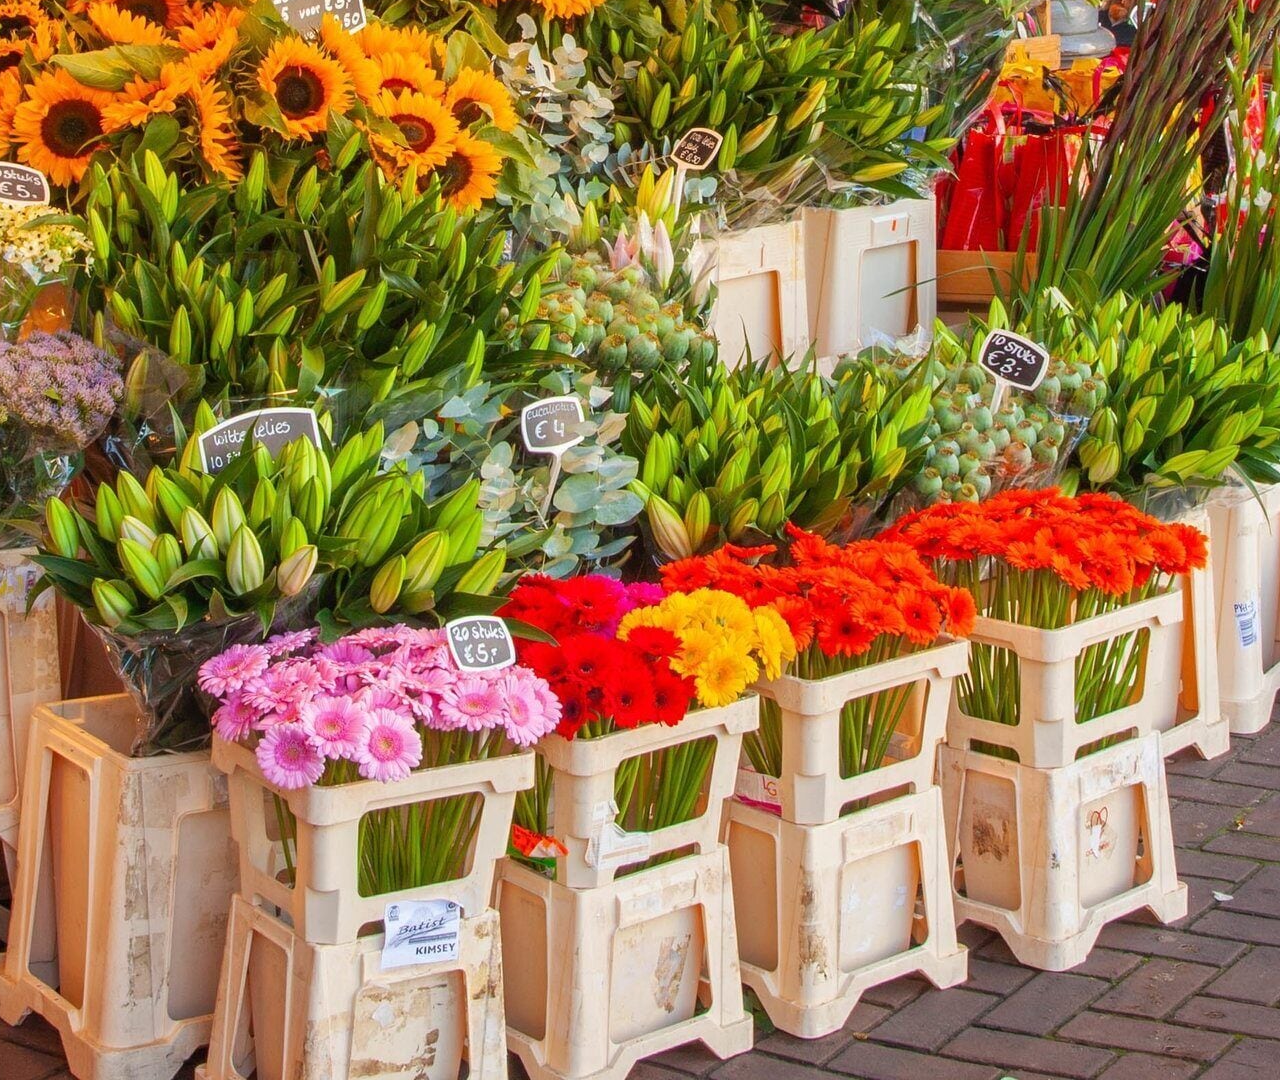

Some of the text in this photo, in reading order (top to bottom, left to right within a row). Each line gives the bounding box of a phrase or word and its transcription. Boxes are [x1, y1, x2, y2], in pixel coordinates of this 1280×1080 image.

[299, 4, 320, 19] voor
[3, 169, 41, 186] stuks
[992, 334, 1037, 365] 10 STUKS
[213, 419, 291, 446] witte lelies
[553, 419, 565, 437] 4
[210, 456, 223, 469] 10
[452, 621, 505, 641] 20 stuks
[397, 916, 446, 936] Batist
[415, 942, 456, 955] KIMSEY
